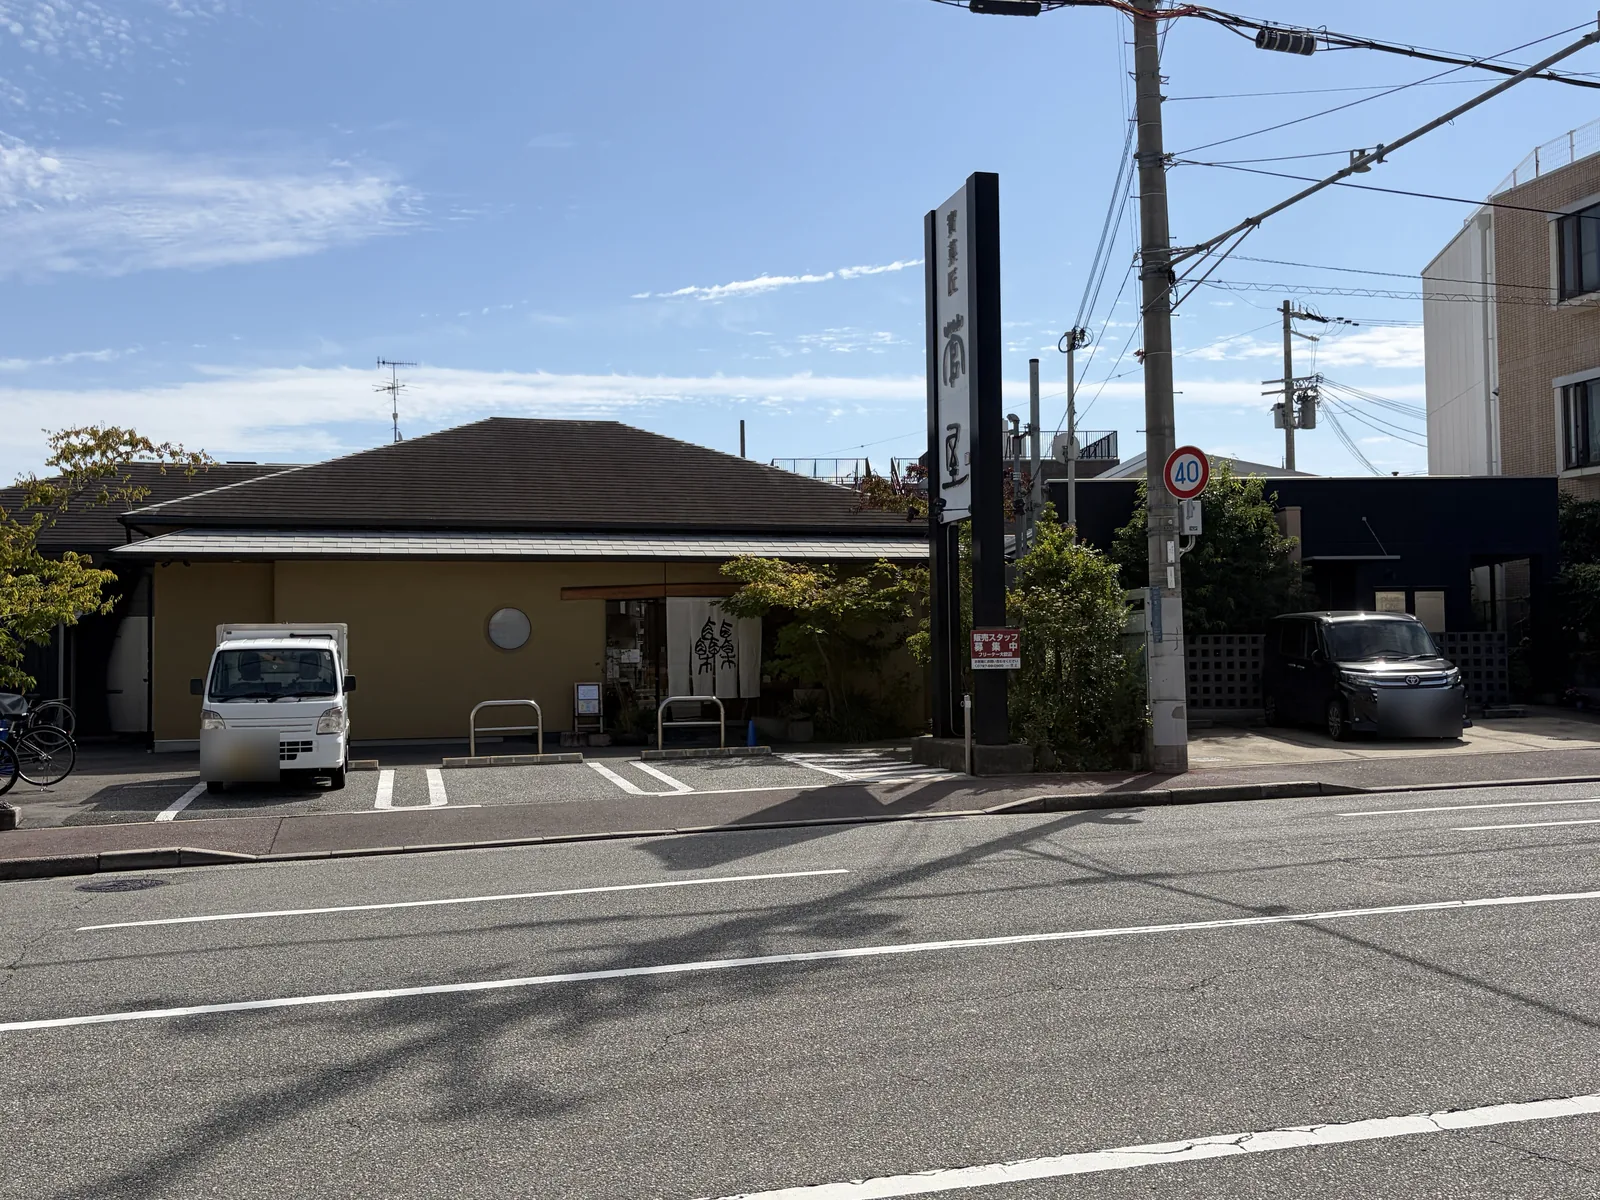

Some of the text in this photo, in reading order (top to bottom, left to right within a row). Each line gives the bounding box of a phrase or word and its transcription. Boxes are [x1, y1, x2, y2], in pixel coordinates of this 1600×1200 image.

[1175, 460, 1199, 485] 40
[973, 633, 1018, 641] 販売スタッフ
[974, 641, 1018, 652] 募集中
